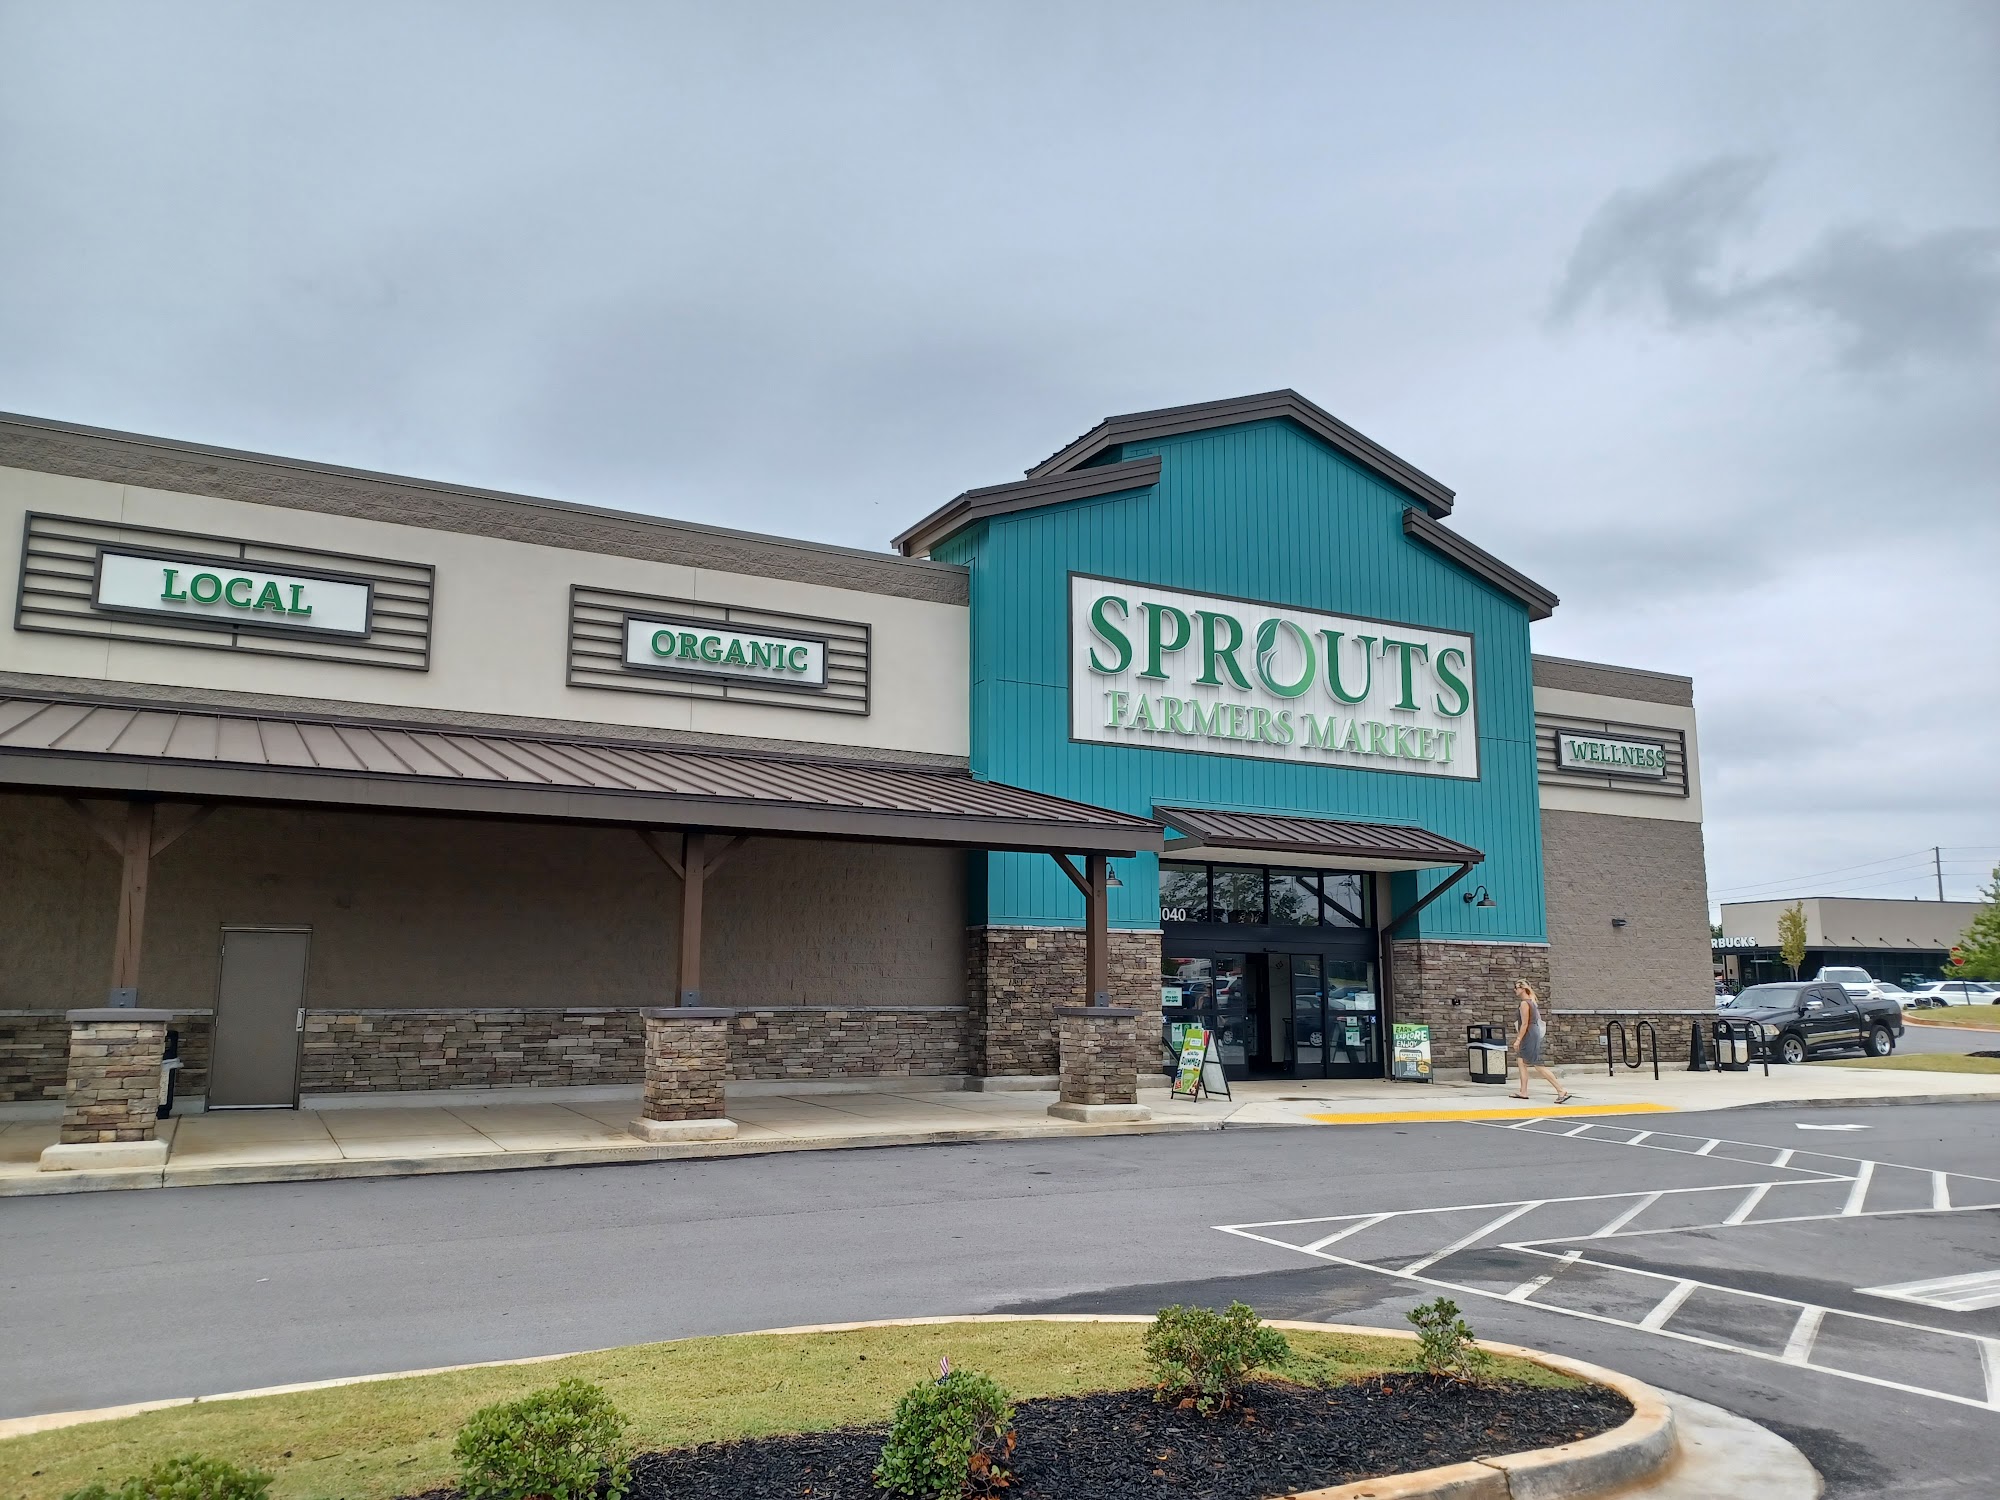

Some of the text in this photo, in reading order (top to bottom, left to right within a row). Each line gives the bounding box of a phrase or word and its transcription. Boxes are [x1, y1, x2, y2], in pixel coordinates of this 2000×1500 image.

[160, 567, 313, 617] LOCAL
[651, 629, 809, 673] ORGANIC
[1088, 595, 1471, 719] SPROUTS
[1104, 689, 1458, 764] FARMERS MARKET
[1567, 739, 1666, 769] WELLNESS
[1159, 907, 1187, 922] 040
[1395, 1030, 1429, 1041] EXPLORE
[1396, 1040, 1418, 1048] ENJOY
